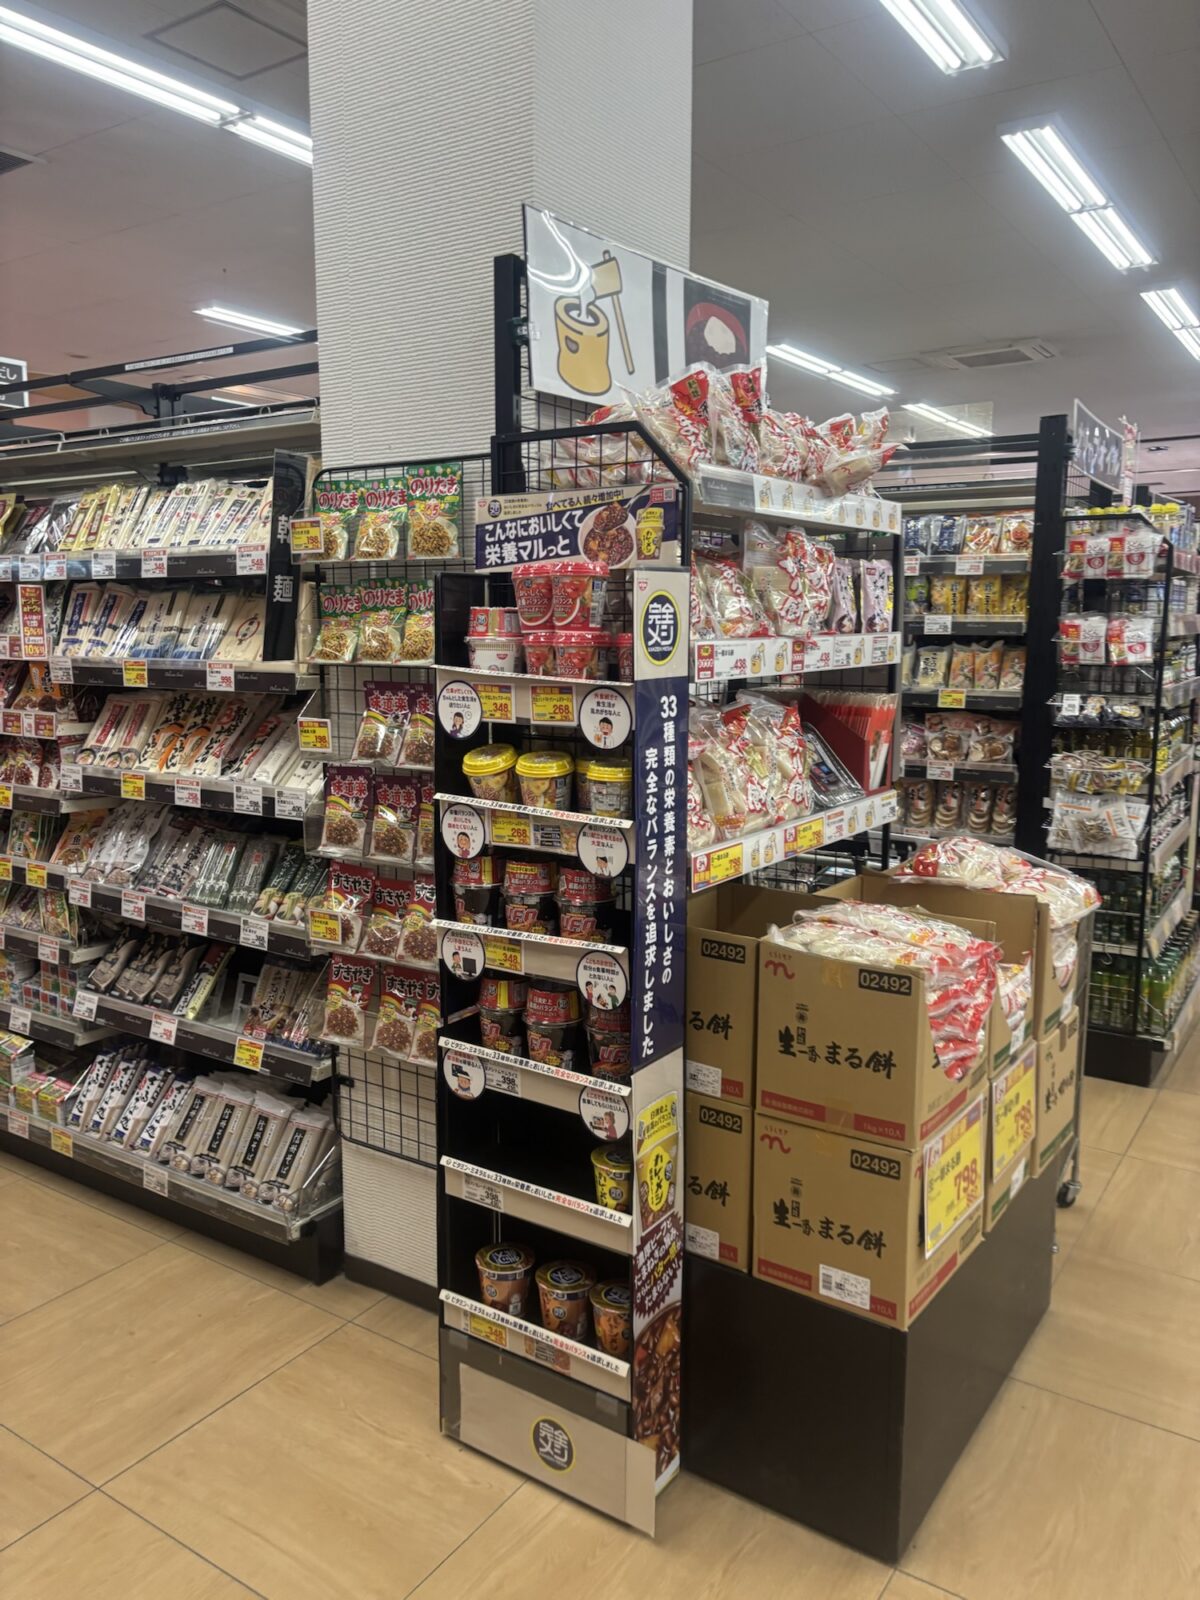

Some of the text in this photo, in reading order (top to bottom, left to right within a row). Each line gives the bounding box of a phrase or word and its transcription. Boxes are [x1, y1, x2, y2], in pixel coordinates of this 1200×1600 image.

[410, 475, 458, 496] のりたま
[318, 491, 360, 509] のりたま
[365, 488, 408, 508] のりたま
[545, 495, 581, 512] 食べてる人
[485, 510, 586, 542] こんなにおいしくて
[485, 536, 570, 567] 栄養マルっと
[323, 593, 362, 612] のりたま
[364, 586, 406, 607] のりたま
[442, 695, 477, 703] ちゃんとした食生活を
[491, 702, 508, 714] 348
[552, 703, 569, 715] 268
[315, 738, 327, 748] 198
[510, 827, 527, 838] 268
[659, 693, 678, 985] 33種類の栄養素とおいしさの
[332, 874, 373, 894] すきやき
[641, 746, 657, 1059] 完全なバランスを追求しました
[326, 926, 337, 935] 198
[500, 952, 517, 964] 348
[702, 943, 744, 963] 02492
[332, 965, 375, 986] すきやき
[859, 972, 909, 996] 02492
[688, 1010, 734, 1041] る餅
[778, 1025, 896, 1080] 生一番まる餅
[501, 1074, 517, 1087] 398
[700, 1109, 741, 1133] 02492
[851, 1154, 901, 1178] 02492
[954, 1157, 978, 1201] 798
[686, 1174, 731, 1208] る餅
[773, 1196, 886, 1260] 生一番まる餅
